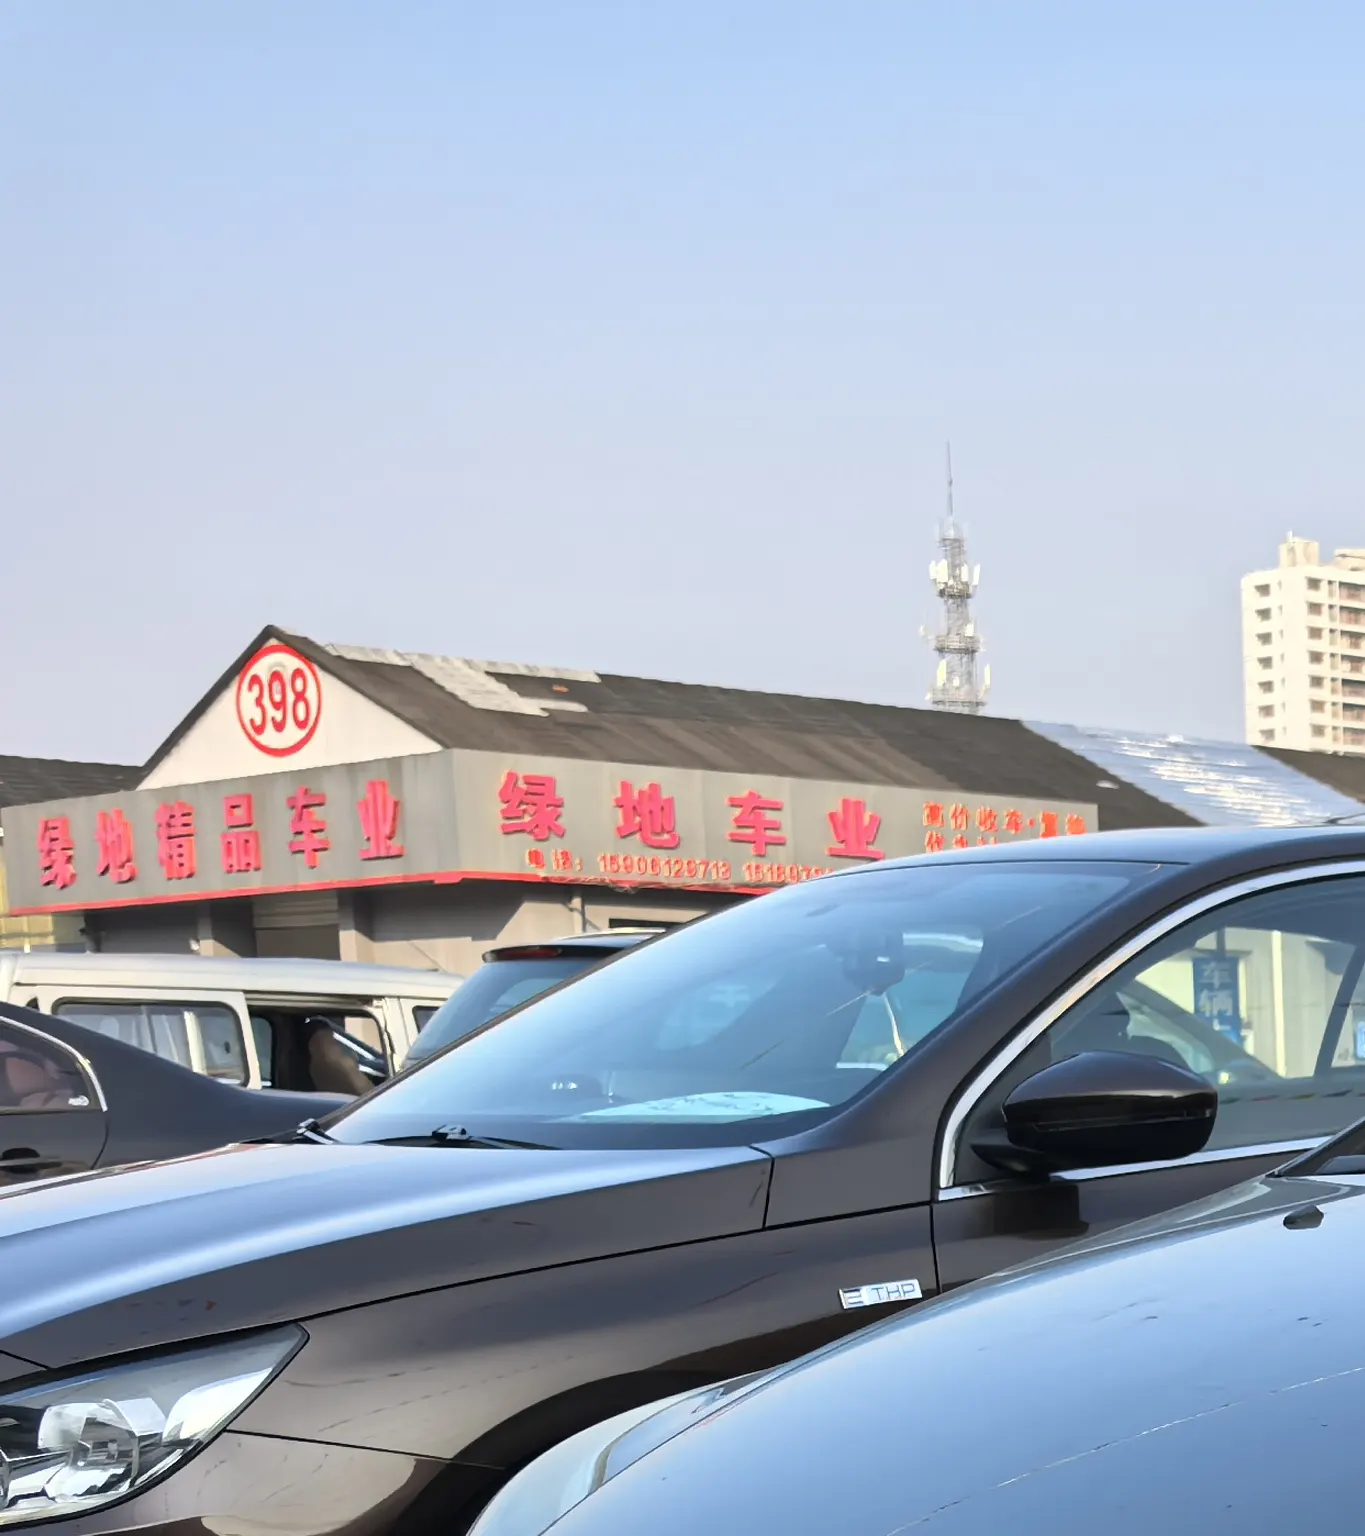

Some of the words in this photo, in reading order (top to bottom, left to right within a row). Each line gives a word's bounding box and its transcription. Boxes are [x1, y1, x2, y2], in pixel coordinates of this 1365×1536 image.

[246, 667, 310, 736] 398
[37, 779, 405, 889] 绿地精品车业
[499, 770, 885, 857] 绿地车业
[871, 1283, 916, 1301] THP
